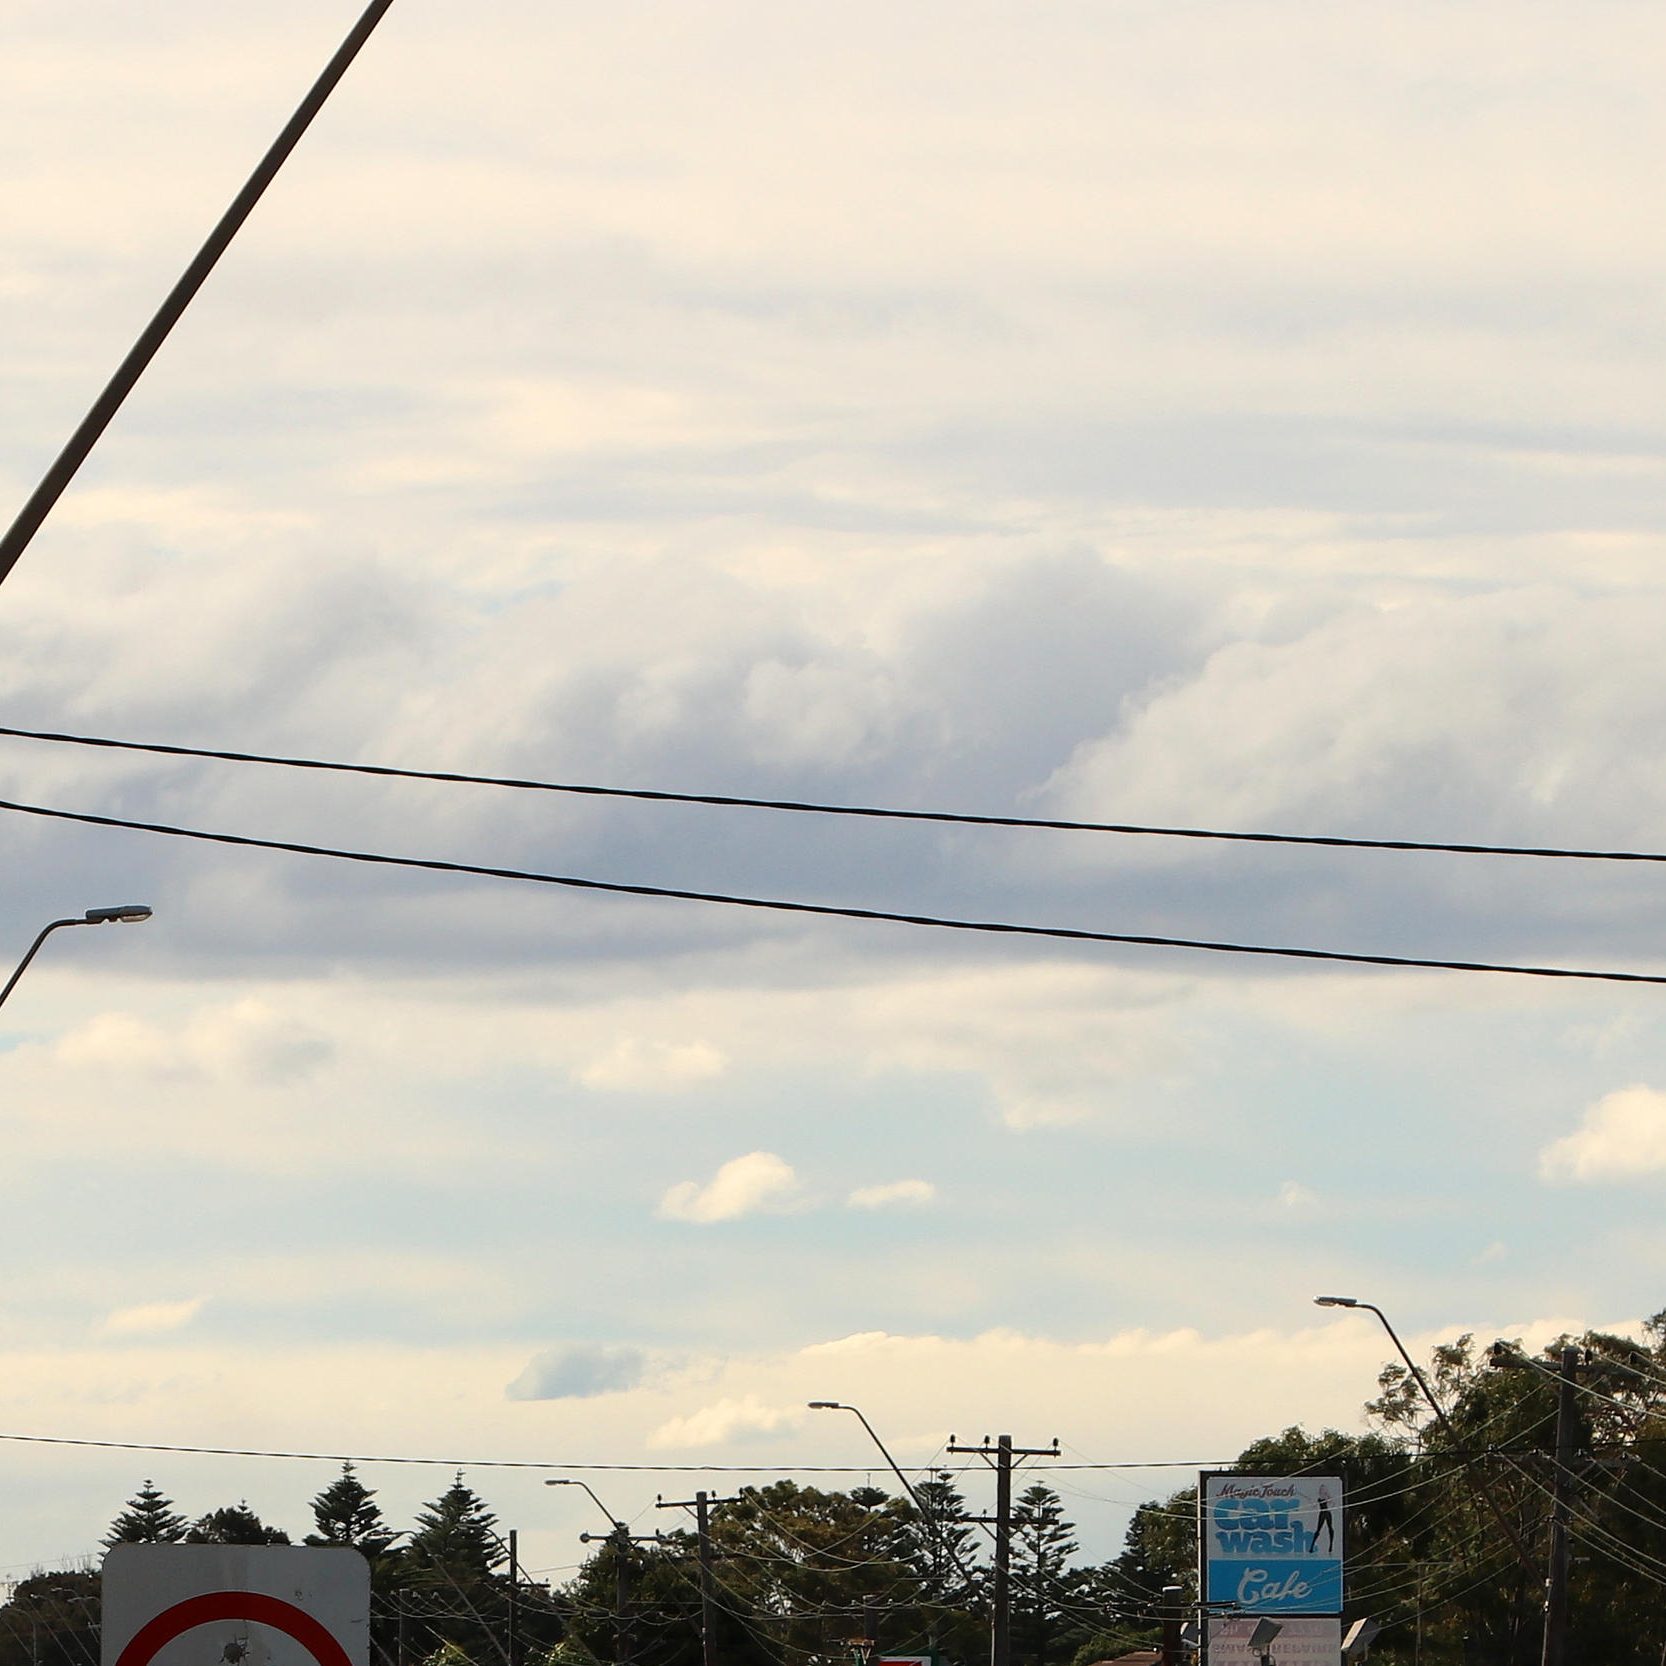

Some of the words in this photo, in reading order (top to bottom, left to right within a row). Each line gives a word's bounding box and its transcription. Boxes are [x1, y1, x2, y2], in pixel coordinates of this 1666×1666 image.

[1216, 1483, 1260, 1499] Magic
[1260, 1484, 1295, 1498] Touch
[1214, 1498, 1301, 1530] car
[1215, 1520, 1319, 1554] wash
[1237, 1567, 1313, 1605] Cafe
